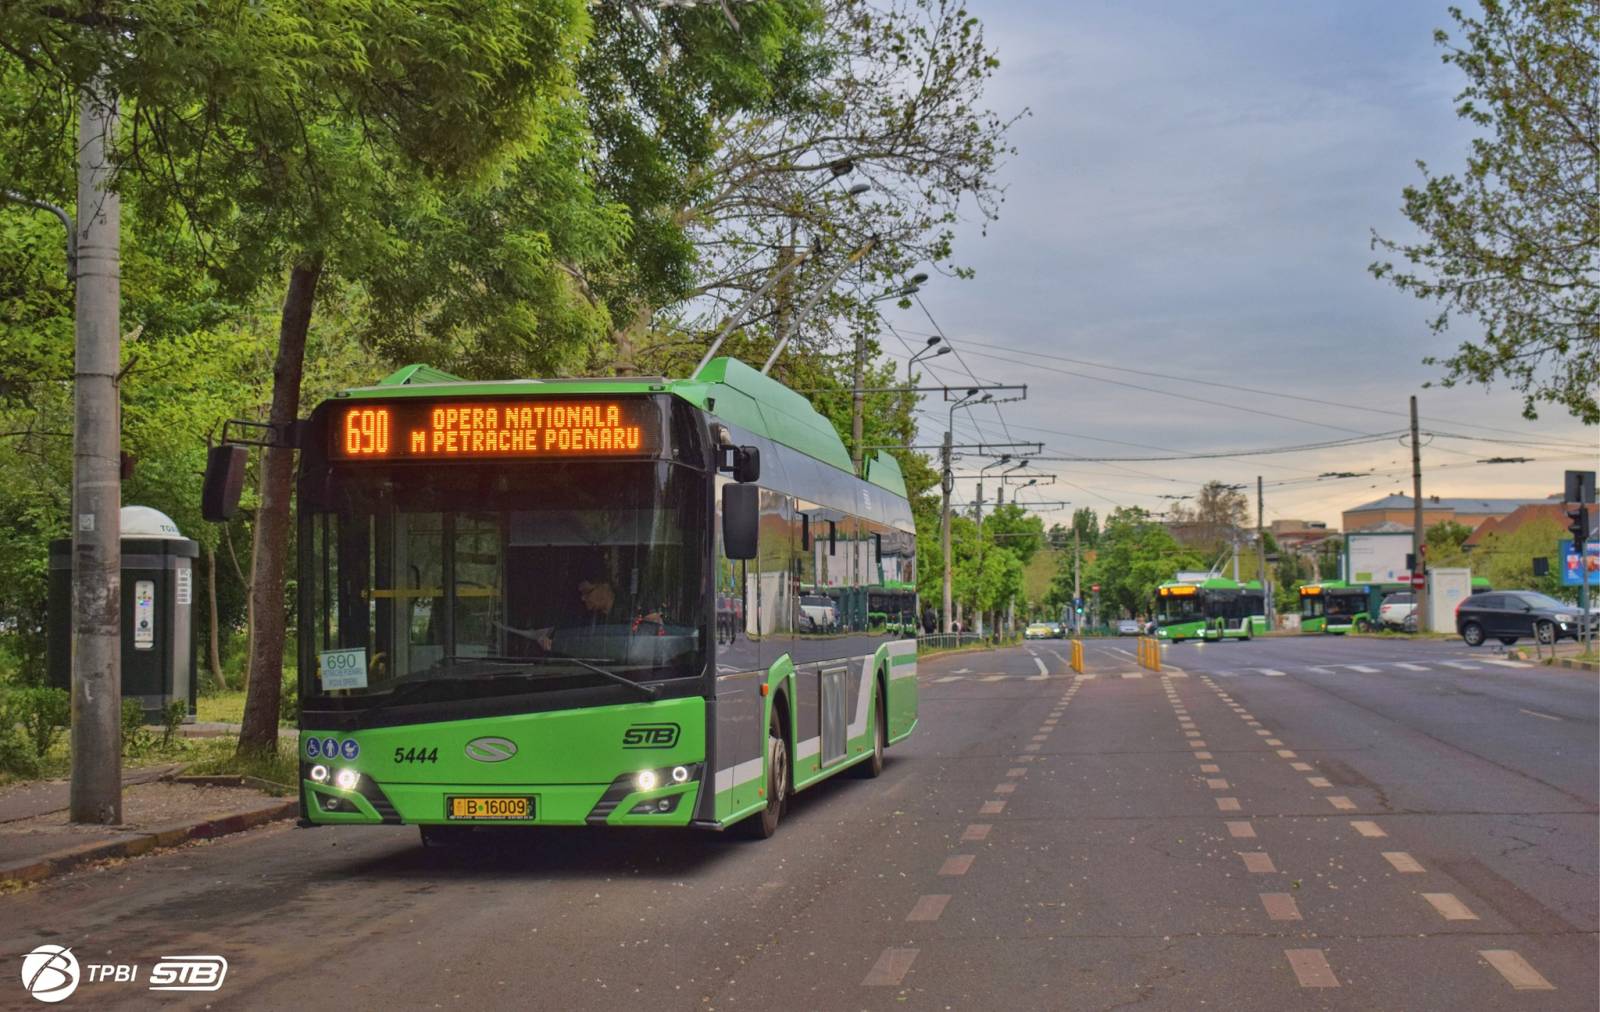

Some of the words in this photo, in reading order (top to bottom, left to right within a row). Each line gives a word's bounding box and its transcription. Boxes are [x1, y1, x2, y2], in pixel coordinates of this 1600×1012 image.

[346, 410, 388, 454] 690
[433, 408, 498, 430] OPERA
[505, 406, 620, 429] NATIONALA
[411, 431, 426, 452] M
[433, 430, 537, 452] PETRACHE
[545, 427, 639, 450] POENARU
[327, 653, 356, 669] 690
[622, 726, 678, 747] STB
[393, 747, 439, 764] 5444
[467, 799, 477, 815] B
[484, 799, 526, 815] 16009
